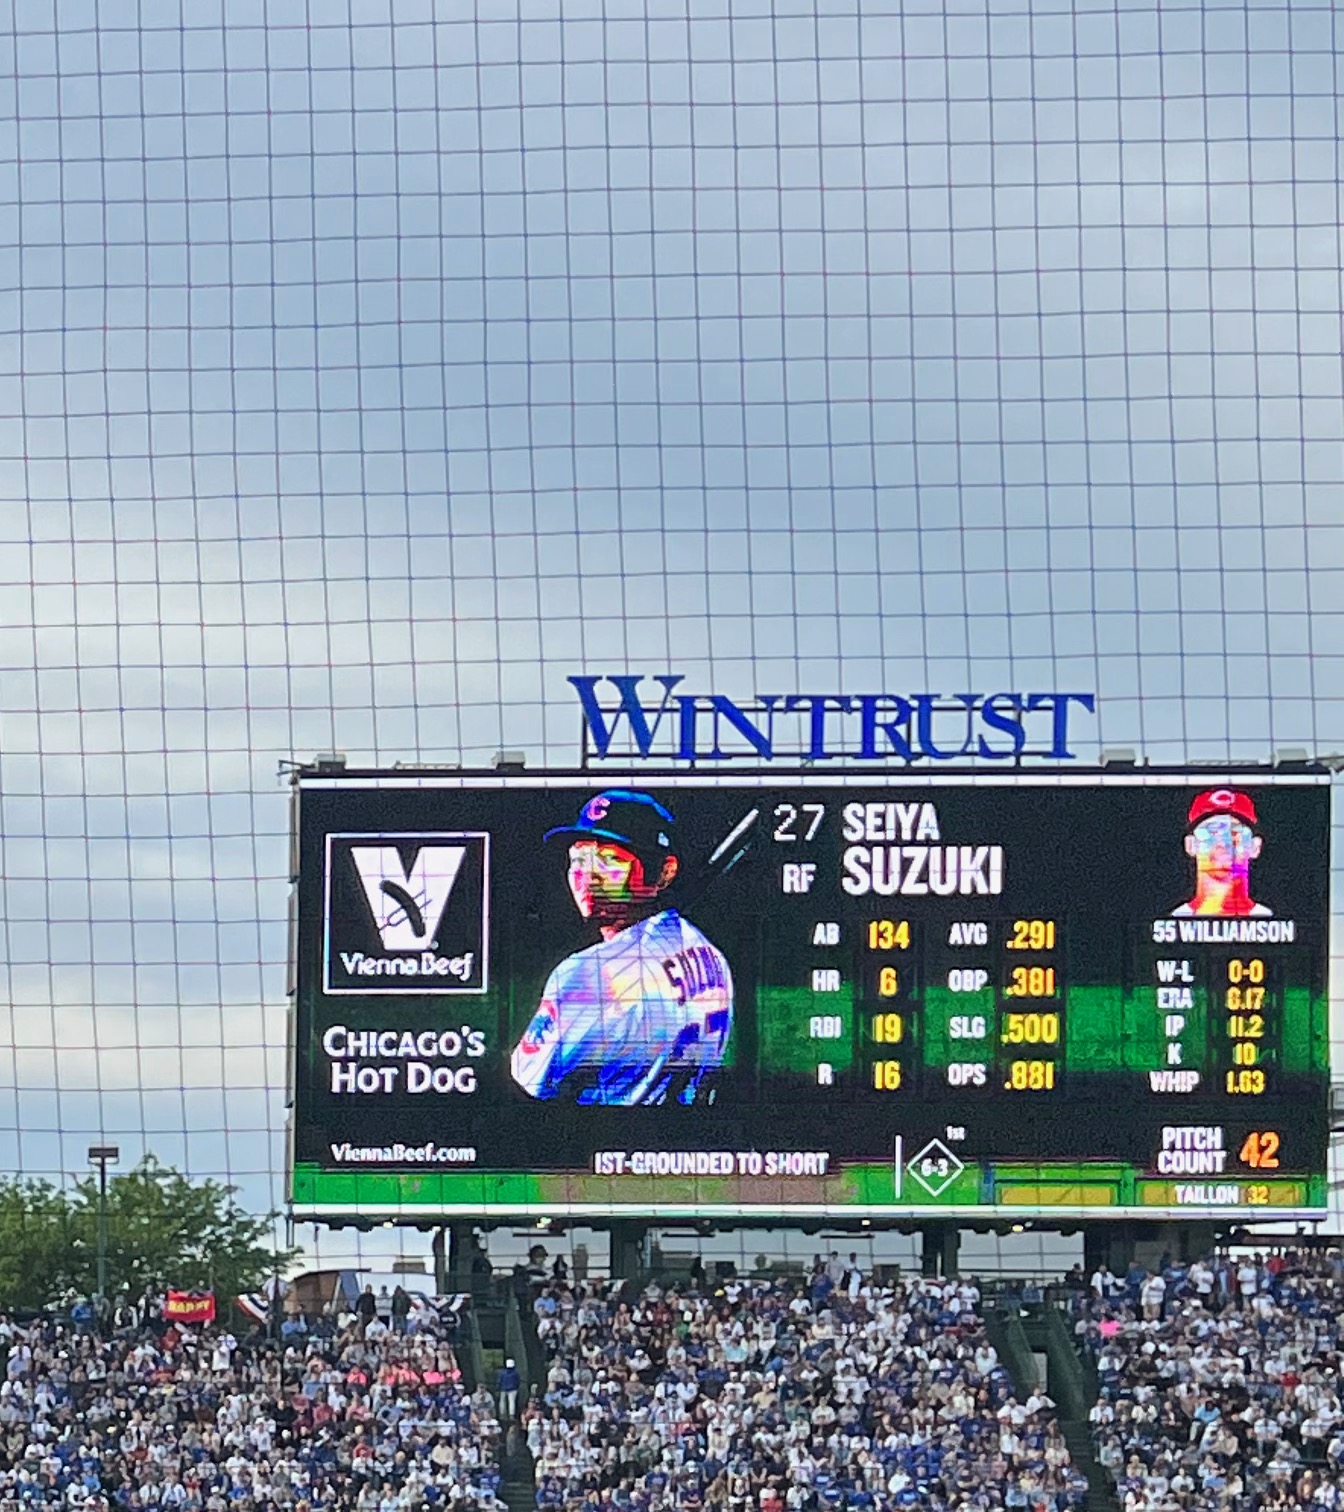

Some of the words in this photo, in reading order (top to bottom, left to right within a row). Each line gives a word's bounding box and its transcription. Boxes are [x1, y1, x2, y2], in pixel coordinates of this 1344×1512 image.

[566, 674, 1096, 763] WINTRUST
[773, 803, 825, 842] 27
[841, 802, 941, 842] SEIYA
[782, 862, 817, 894] RF
[841, 845, 1004, 896] SUZUKI
[812, 922, 841, 945] AB
[868, 920, 910, 950] 134
[948, 922, 989, 946] AVG
[1005, 919, 1056, 950] .291
[1152, 919, 1176, 944] 55
[1179, 919, 1295, 944] WILLIAMSON
[811, 968, 841, 992] HR
[879, 967, 898, 997] 6
[947, 968, 989, 992] OBP
[1005, 967, 1056, 998] .381
[1156, 960, 1195, 983] W-L
[1227, 960, 1264, 984] 0-0
[1156, 987, 1193, 1010] ERA
[810, 1015, 842, 1039] RBI
[872, 1013, 903, 1044] 19
[949, 1015, 987, 1039] SLG
[1000, 1013, 1059, 1045] .500
[1165, 1015, 1185, 1038] IP
[322, 1024, 487, 1060] CHICAGO'S
[1166, 1042, 1182, 1066] K
[1234, 1042, 1256, 1066] 10
[330, 1062, 400, 1094] HOT
[406, 1062, 477, 1094] DOG
[817, 1062, 833, 1086] R
[873, 1060, 902, 1090] 16
[947, 1062, 987, 1086] OPS
[1004, 1060, 1055, 1091] .881
[1149, 1070, 1200, 1094] WHIP
[331, 1143, 477, 1163] ViennaBeef.com
[1161, 1126, 1223, 1151] PITCH
[1239, 1131, 1281, 1169] 42
[736, 1151, 762, 1176] TO
[764, 1151, 830, 1176] SHORT
[921, 1158, 949, 1178] 6-3
[1157, 1150, 1226, 1175] COUNT
[1175, 1184, 1240, 1206] TAILLON
[1247, 1184, 1269, 1206] 32
